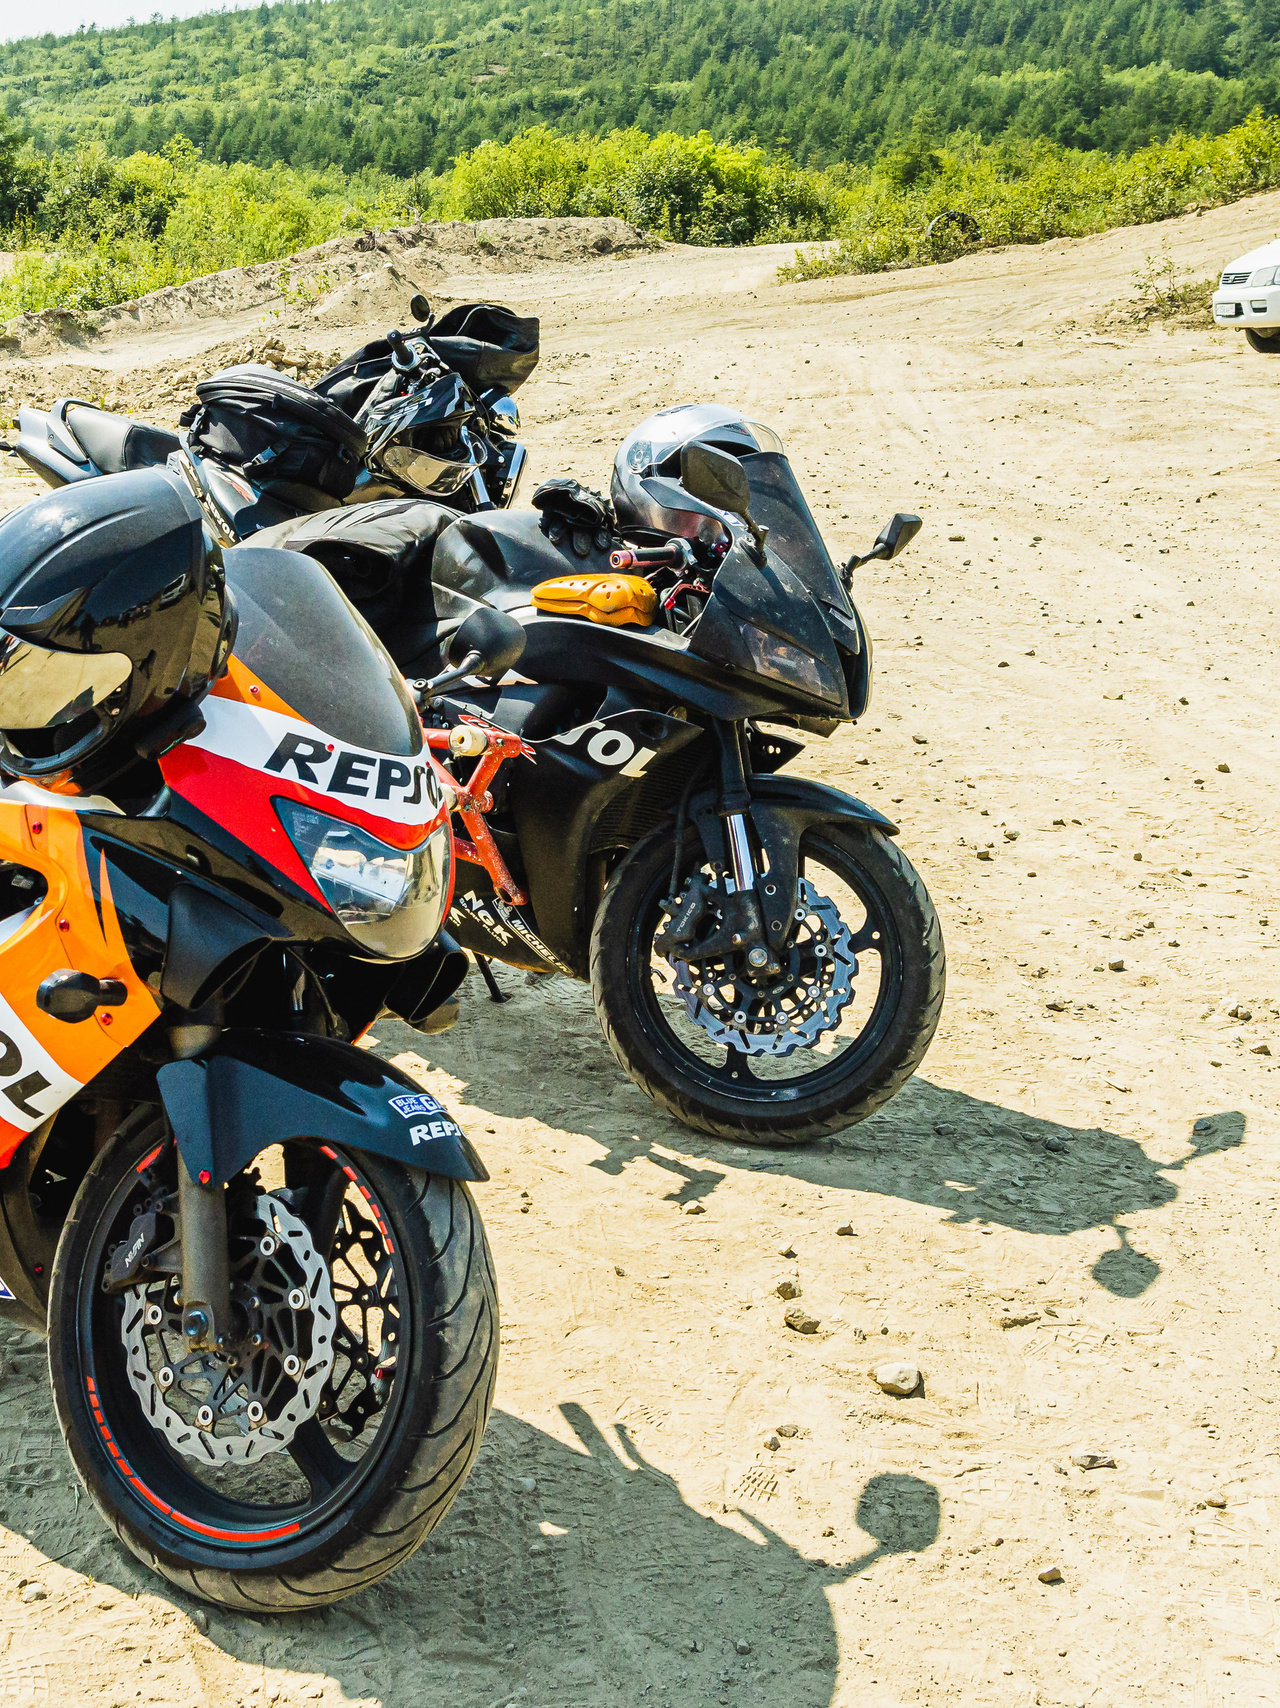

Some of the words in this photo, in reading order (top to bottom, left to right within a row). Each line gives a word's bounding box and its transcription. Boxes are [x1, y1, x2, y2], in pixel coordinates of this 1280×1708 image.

[263, 732, 445, 809] REPSO
[459, 898, 481, 922] SPARK
[482, 924, 506, 947] PLUGS
[463, 890, 513, 944] NGK
[676, 902, 696, 933] TOKICO
[511, 919, 570, 972] MICHELIN
[395, 1097, 419, 1107] BLUE
[403, 1104, 426, 1114] JEANS
[409, 1121, 467, 1146] REPS
